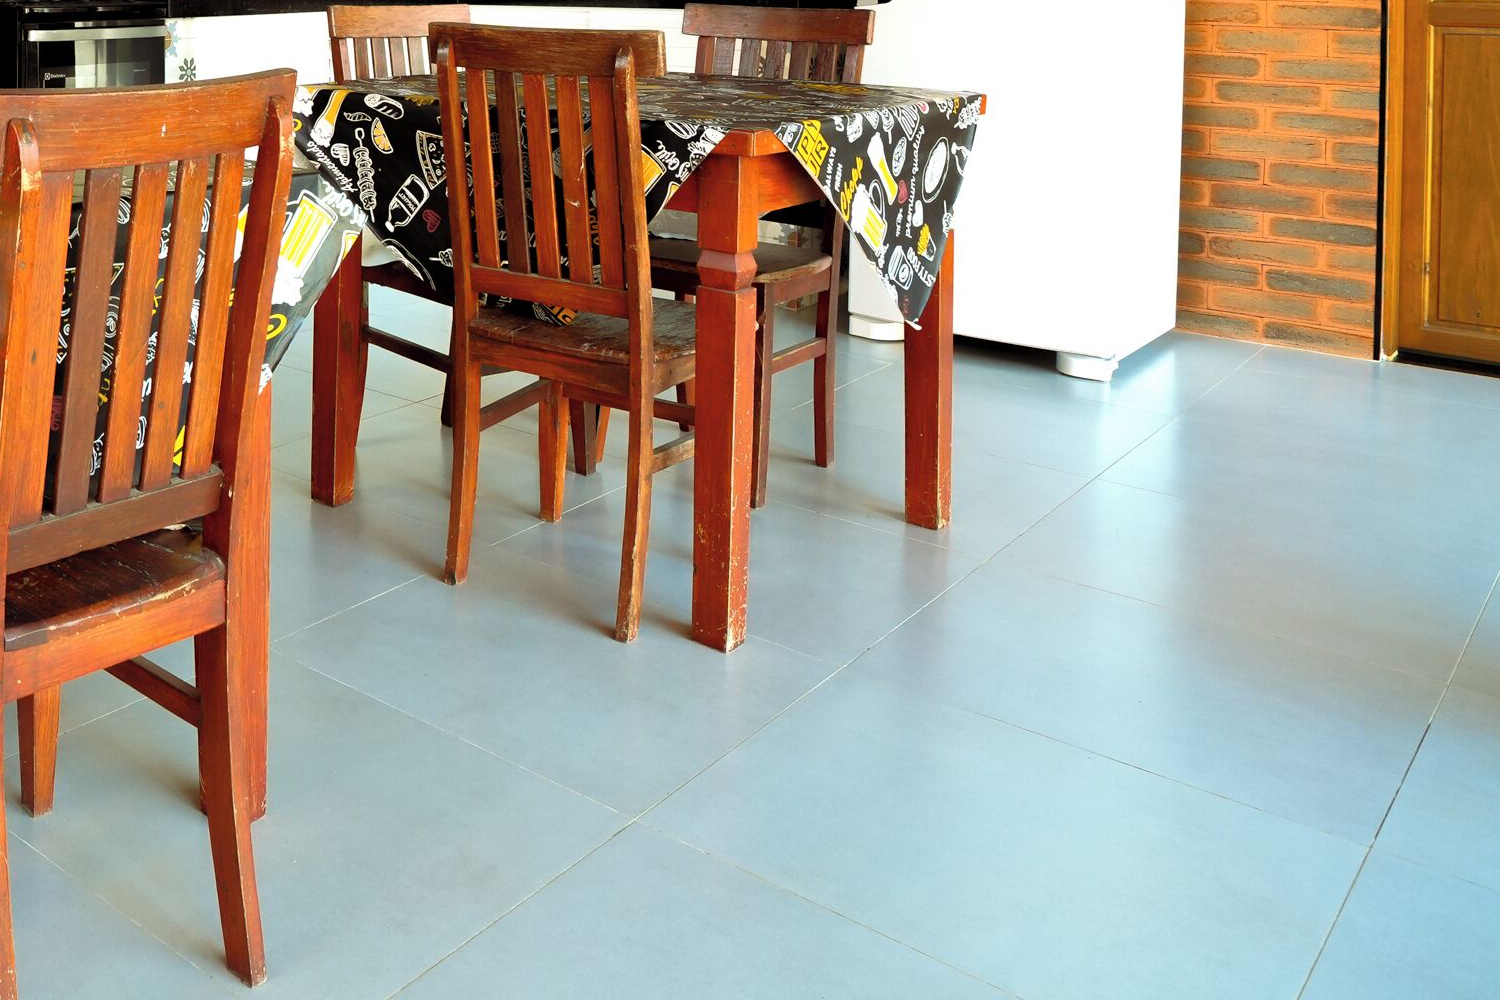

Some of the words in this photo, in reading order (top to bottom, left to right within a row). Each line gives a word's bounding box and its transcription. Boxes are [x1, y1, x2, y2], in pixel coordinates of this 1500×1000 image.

[306, 140, 359, 193] Apimentado
[825, 146, 837, 189] ALWAYS
[835, 163, 844, 192] FRESH
[840, 156, 864, 222] Chopp
